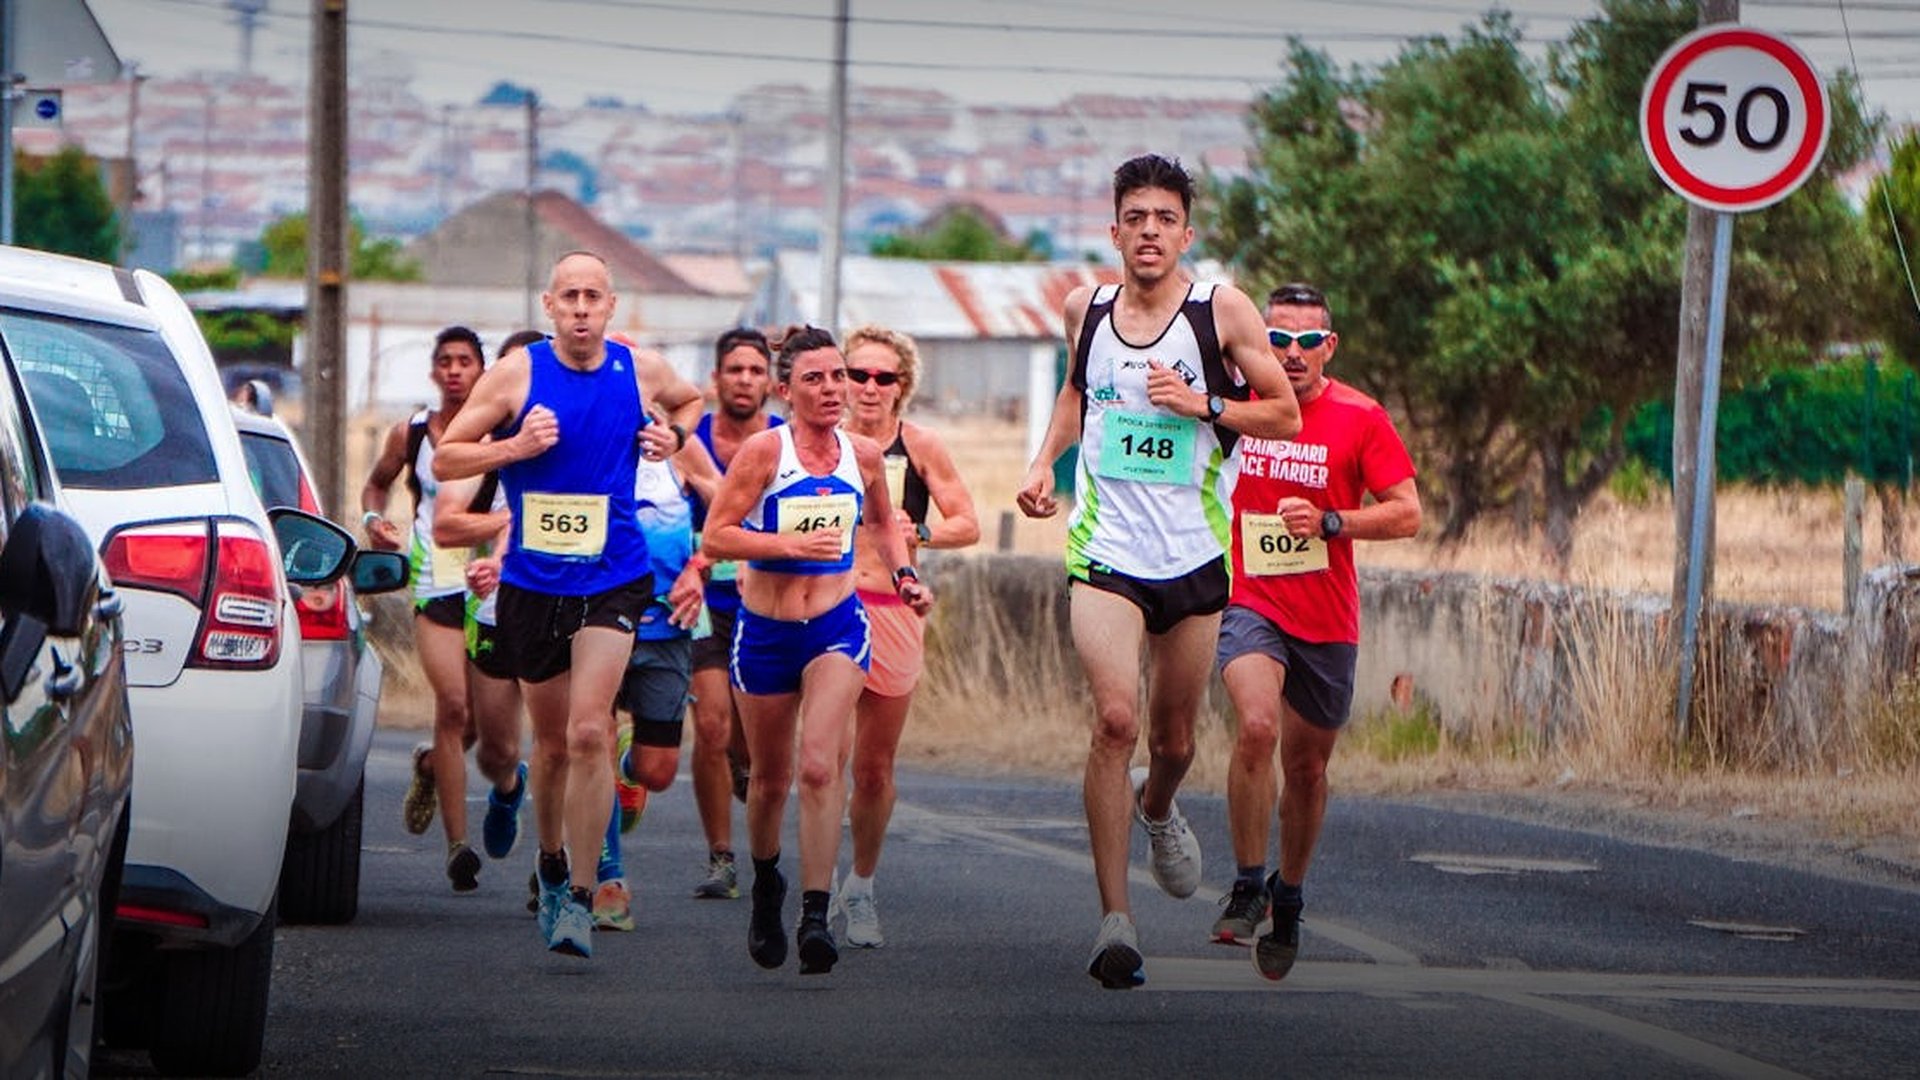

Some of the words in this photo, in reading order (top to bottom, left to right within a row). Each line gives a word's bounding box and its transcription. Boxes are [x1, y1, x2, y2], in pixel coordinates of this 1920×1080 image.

[1678, 82, 1790, 151] 50
[1121, 434, 1174, 460] 148
[1291, 442, 1328, 464] HARD
[1239, 454, 1266, 477] ACE
[1269, 459, 1329, 486] HARDER
[540, 513, 589, 534] 563
[794, 515, 841, 534] 464
[1260, 534, 1310, 554] 602
